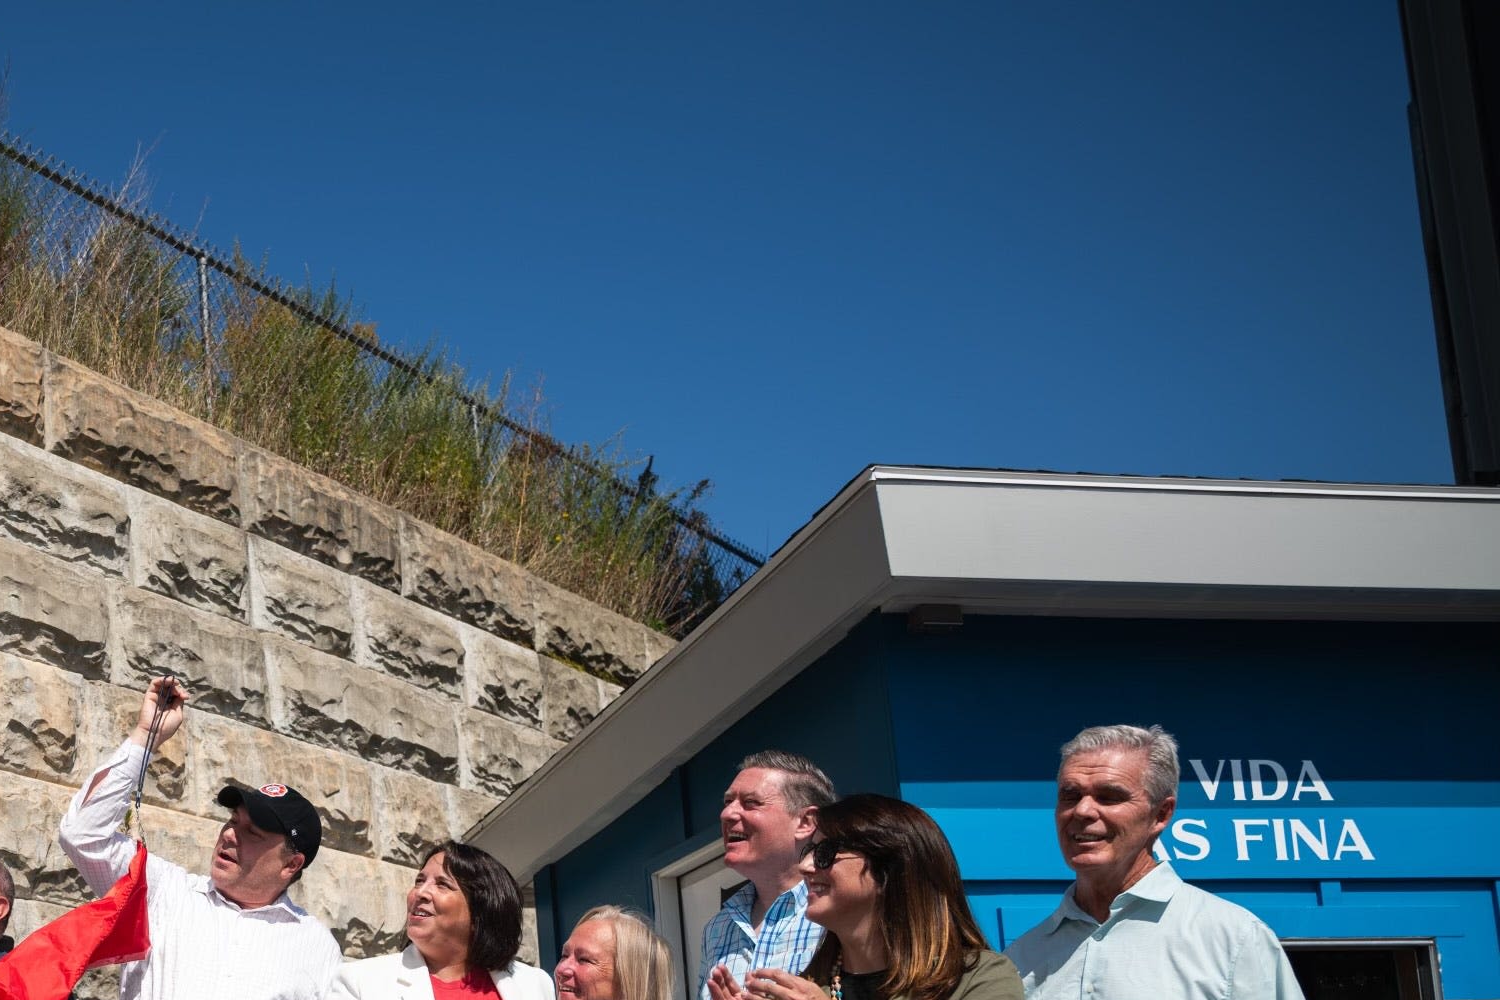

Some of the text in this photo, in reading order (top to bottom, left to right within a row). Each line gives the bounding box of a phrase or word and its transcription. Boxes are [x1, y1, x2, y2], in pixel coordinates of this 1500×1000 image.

[1188, 759, 1335, 801] VIDA
[1152, 818, 1376, 861] S FINA
